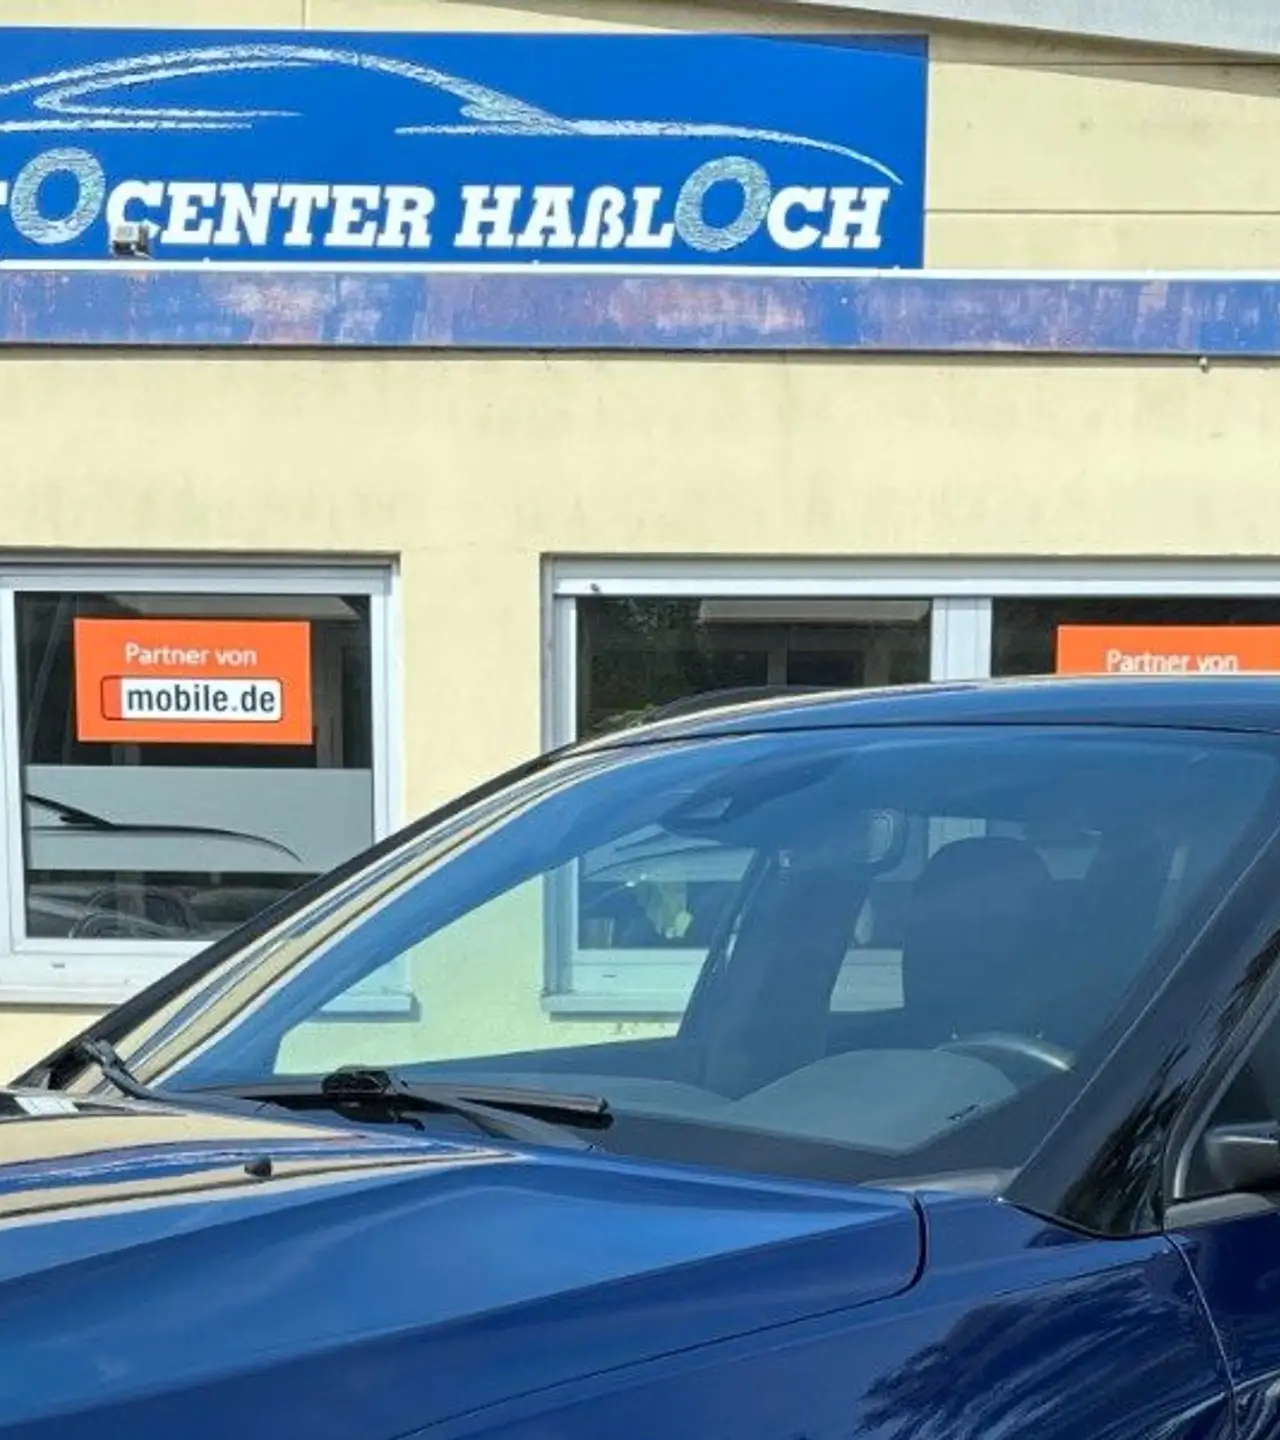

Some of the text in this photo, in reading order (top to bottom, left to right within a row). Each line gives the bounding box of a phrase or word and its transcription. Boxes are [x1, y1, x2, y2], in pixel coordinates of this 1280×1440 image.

[454, 155, 890, 252] HAßLOCH
[124, 642, 257, 667] Partner von
[1106, 648, 1239, 673] Partner von
[127, 683, 276, 713] mobile.de
